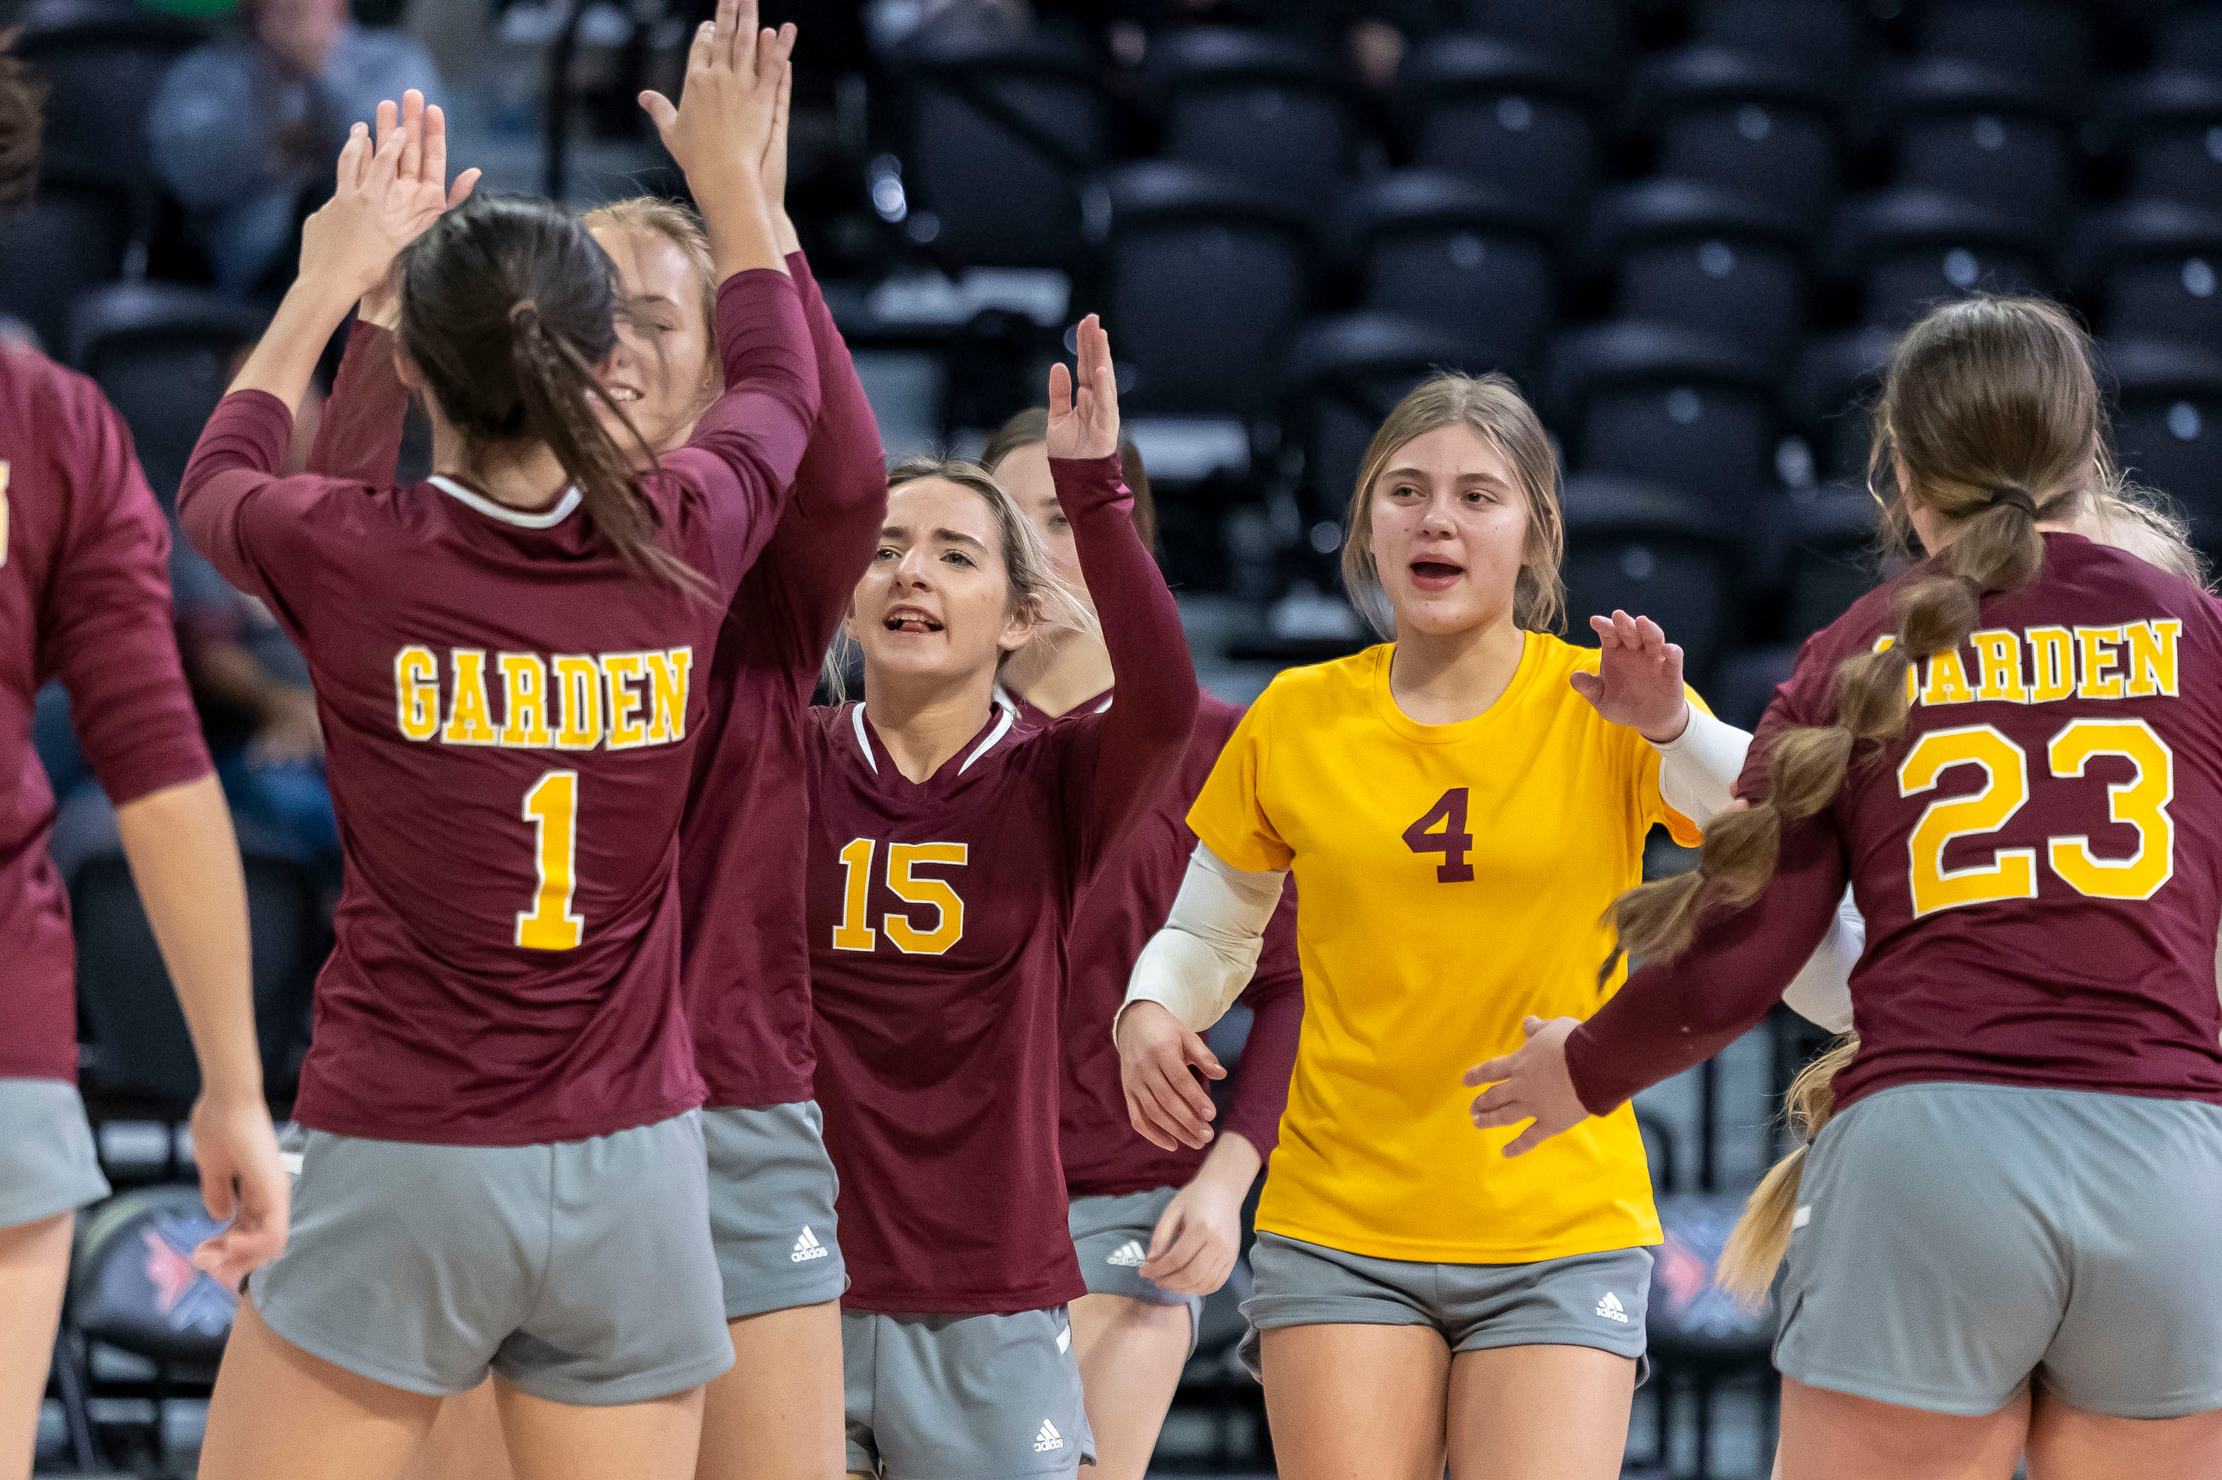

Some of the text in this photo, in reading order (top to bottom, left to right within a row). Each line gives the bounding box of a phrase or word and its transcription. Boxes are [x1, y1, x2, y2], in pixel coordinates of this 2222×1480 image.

[395, 644, 693, 750] GARDEN
[1873, 618, 2182, 706] ARDEN
[515, 770, 585, 950] 1
[1401, 787, 1475, 883] 4
[1897, 718, 2174, 919] 23
[832, 837, 968, 955] 15
[791, 1247, 828, 1262] adidas
[1033, 1438, 1063, 1453] adidas
